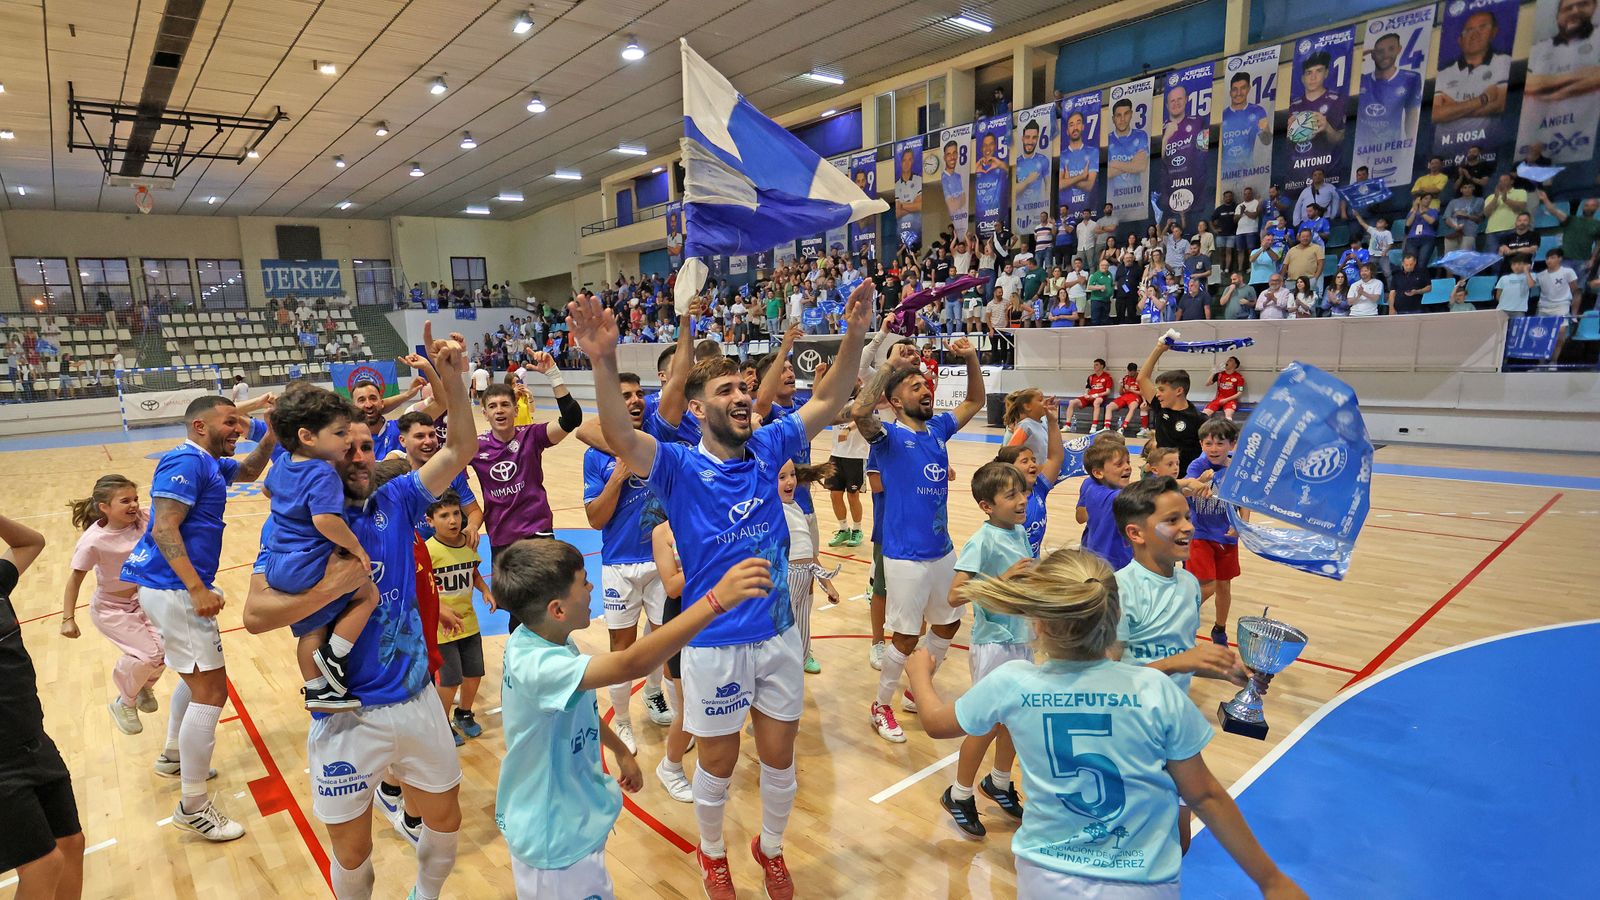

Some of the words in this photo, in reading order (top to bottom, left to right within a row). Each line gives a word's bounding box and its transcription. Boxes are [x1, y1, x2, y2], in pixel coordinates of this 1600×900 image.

[1385, 15, 1431, 32] FUTSAL
[1387, 8, 1431, 24] XEREZ
[1314, 36, 1353, 50] FUTSAL
[1318, 31, 1351, 43] XEREZ
[1246, 50, 1276, 62] XEREZ
[1398, 26, 1425, 70] 4
[1243, 54, 1278, 66] FUTSAL
[1181, 70, 1213, 82] FUTSAL
[1184, 65, 1211, 77] XEREZ
[1333, 55, 1346, 88] 1
[1124, 86, 1152, 97] FUTSAL
[1127, 81, 1151, 91] XEREZ
[1252, 73, 1277, 105] 14
[1187, 87, 1213, 117] 15
[1135, 103, 1147, 130] 3
[1086, 113, 1099, 140] 7
[1223, 127, 1251, 139] GROW
[1039, 126, 1049, 150] 6
[1165, 134, 1193, 151] GROW
[1223, 138, 1234, 147] UP
[1456, 129, 1487, 143] ROSA
[959, 144, 968, 166] 8
[997, 136, 1008, 159] 5
[1165, 148, 1177, 157] UP
[1357, 142, 1382, 156] SAMU
[1293, 154, 1332, 169] ANTONIO
[1374, 155, 1393, 166] BAR
[1221, 168, 1242, 181] JAIME
[1243, 165, 1270, 177] RAMOS
[867, 171, 875, 192] 9
[1171, 176, 1193, 188] JUAKI
[1071, 194, 1086, 204] KIKE
[264, 267, 341, 293] JEREZ
[950, 369, 991, 377] LES
[490, 480, 526, 498] NIMAUTO
[1020, 692, 1143, 708] XEREZFUTSAL
[1042, 712, 1127, 824] 5
[1039, 847, 1053, 857] EL
[1056, 851, 1092, 864] PINAR
[1109, 858, 1146, 869] JEREZ
